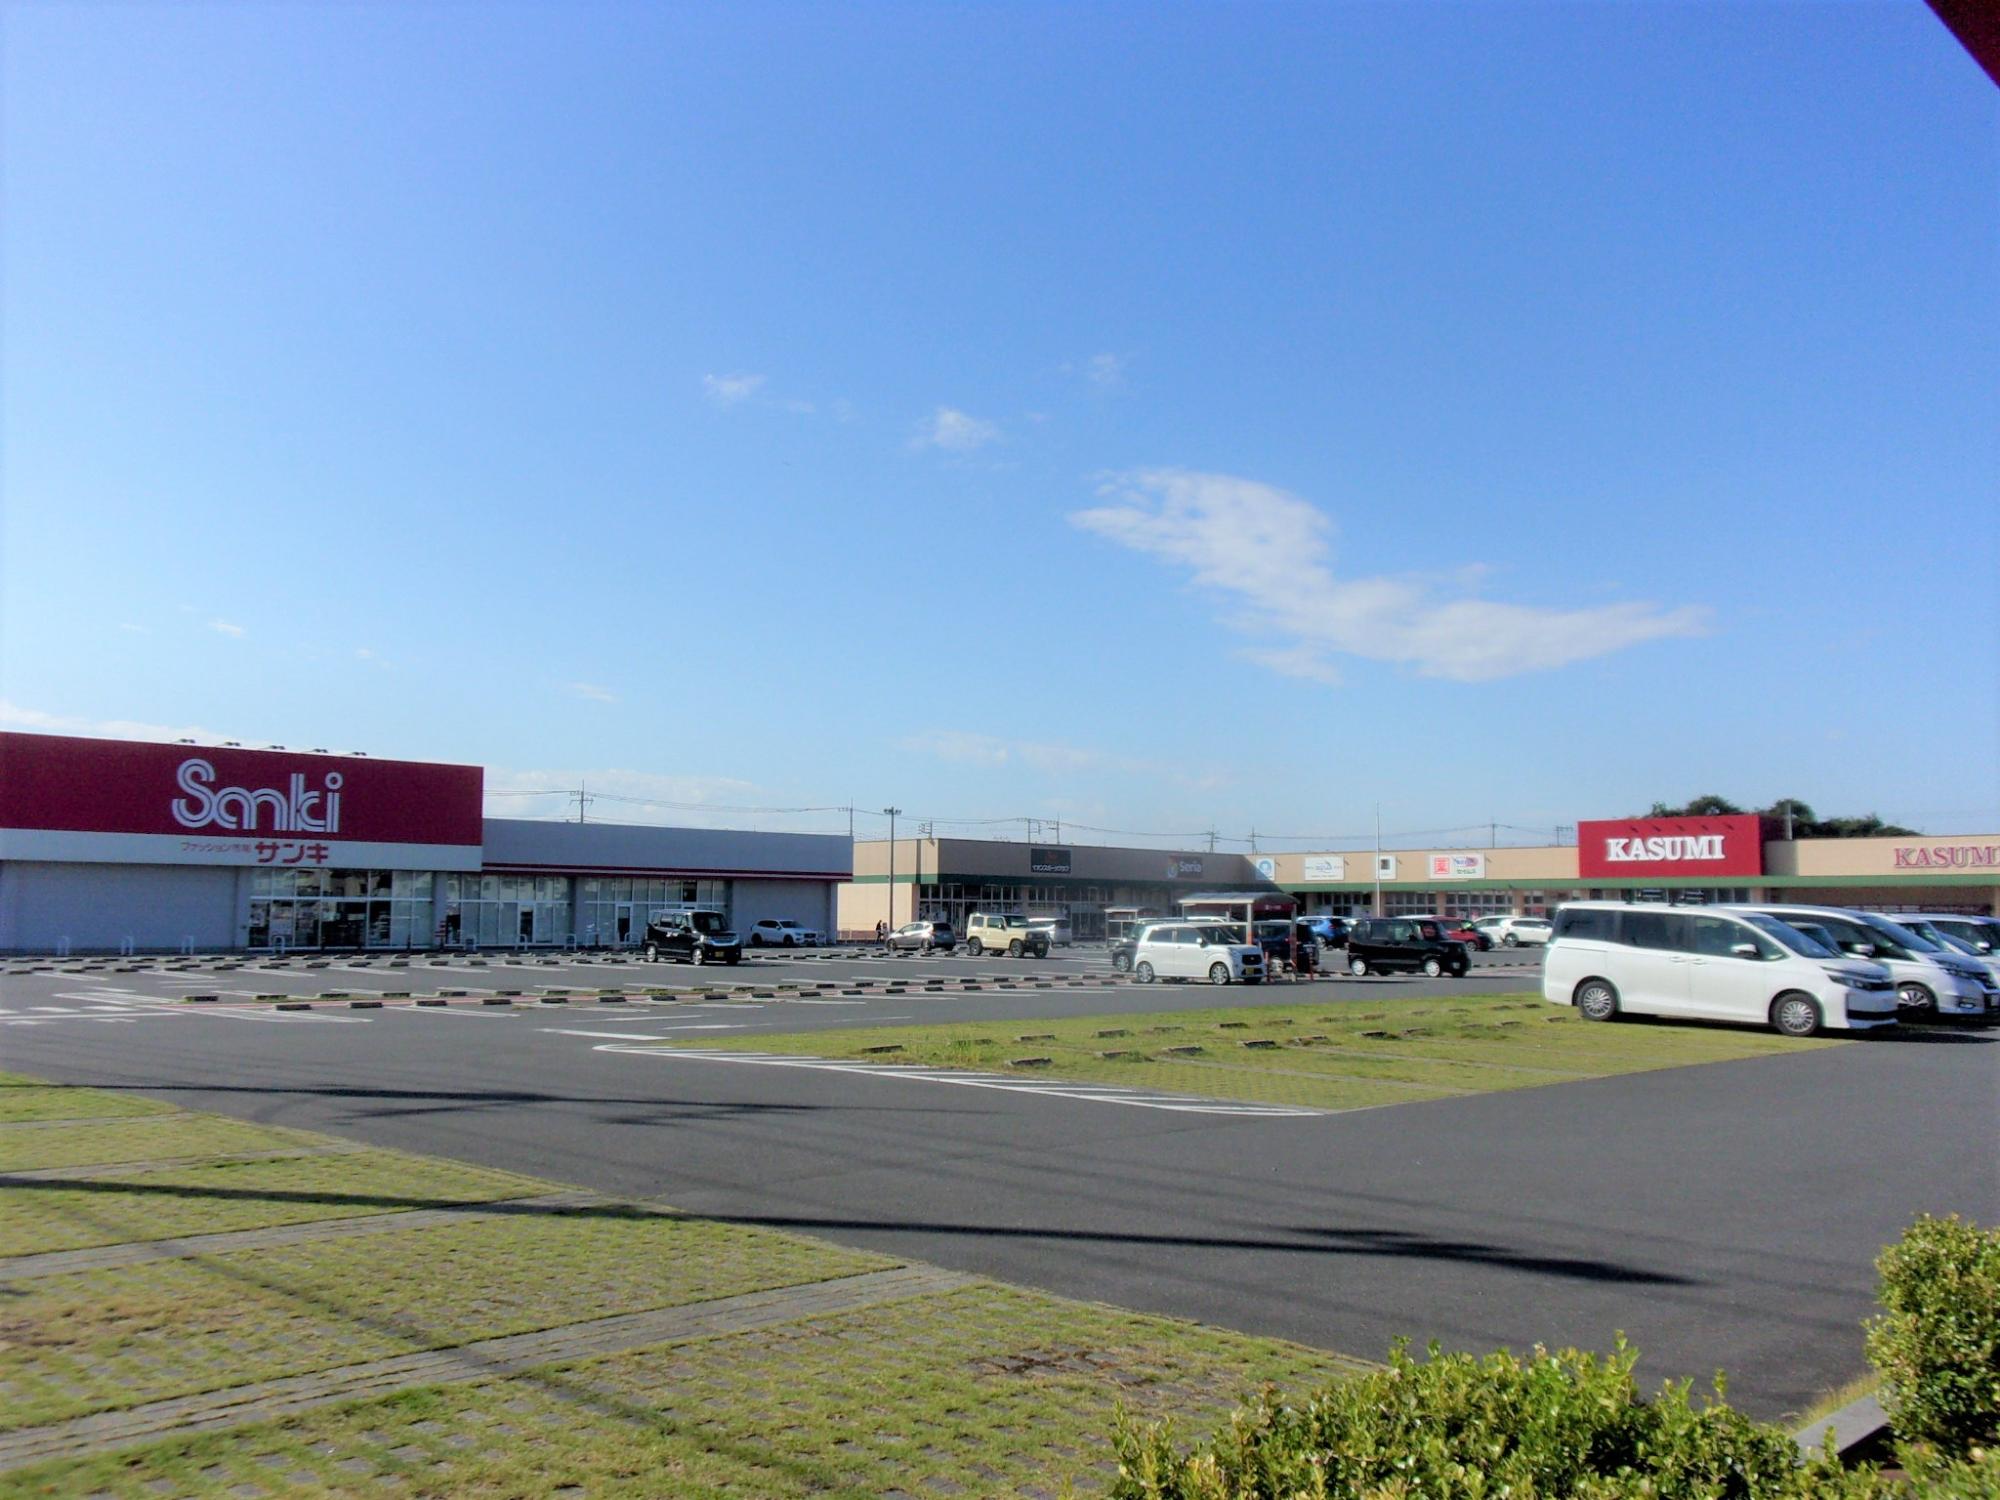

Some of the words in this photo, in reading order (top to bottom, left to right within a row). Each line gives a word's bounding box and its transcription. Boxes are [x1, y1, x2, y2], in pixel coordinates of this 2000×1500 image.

[172, 758, 343, 832] Sanki
[255, 841, 329, 864] サンキ
[1605, 835, 1726, 862] KASUMI
